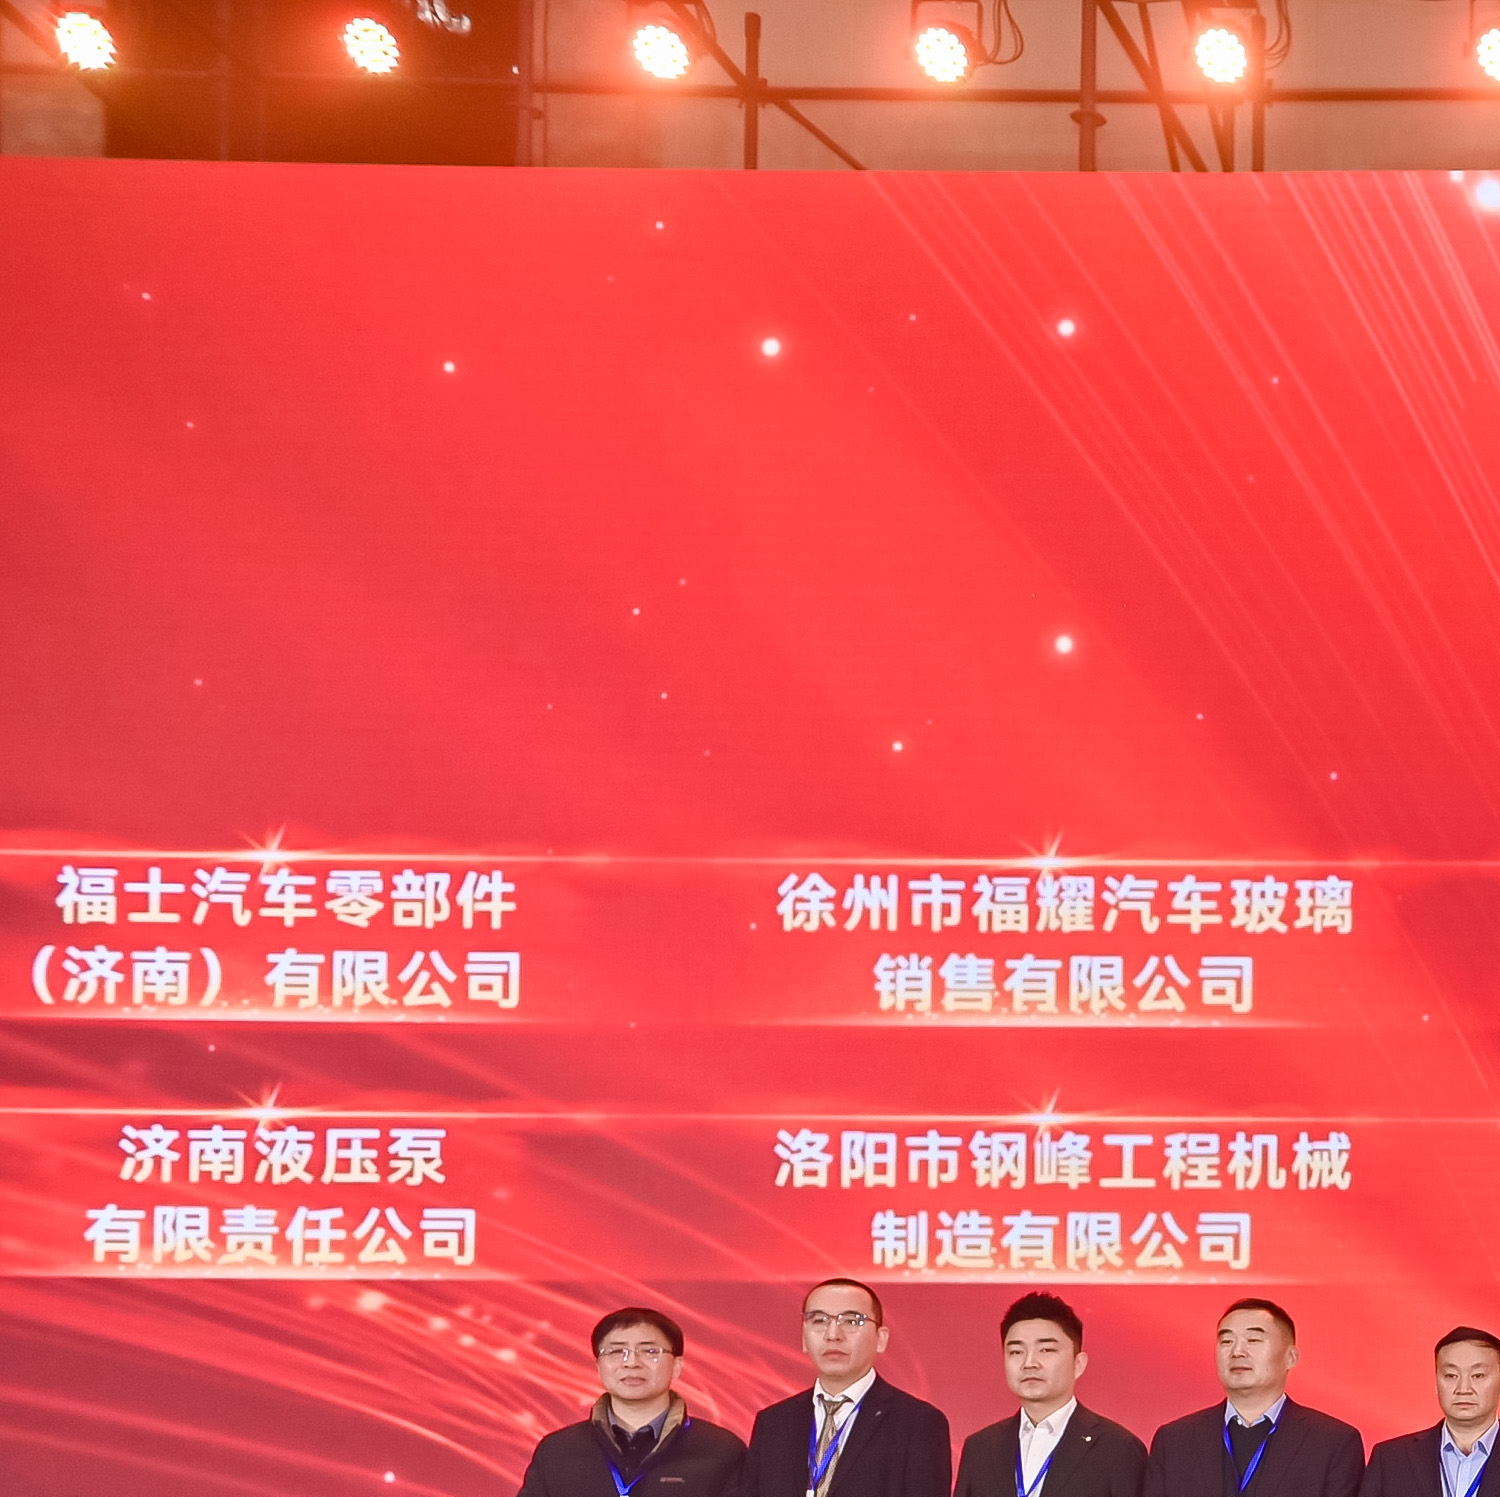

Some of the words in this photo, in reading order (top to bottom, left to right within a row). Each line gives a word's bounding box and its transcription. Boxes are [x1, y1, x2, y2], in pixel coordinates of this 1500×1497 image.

[55, 865, 516, 929] 福士汽车零部件
[775, 872, 1354, 935] 徐州市福耀汽车玻璃
[872, 954, 1255, 1014] 销售有限公司
[118, 1124, 447, 1185] 济南液压泵
[773, 1129, 1352, 1190] 洛阳市钢峰工程机械
[83, 1204, 477, 1266] 有限责任公司
[871, 1210, 1251, 1270] 制造有限公司
